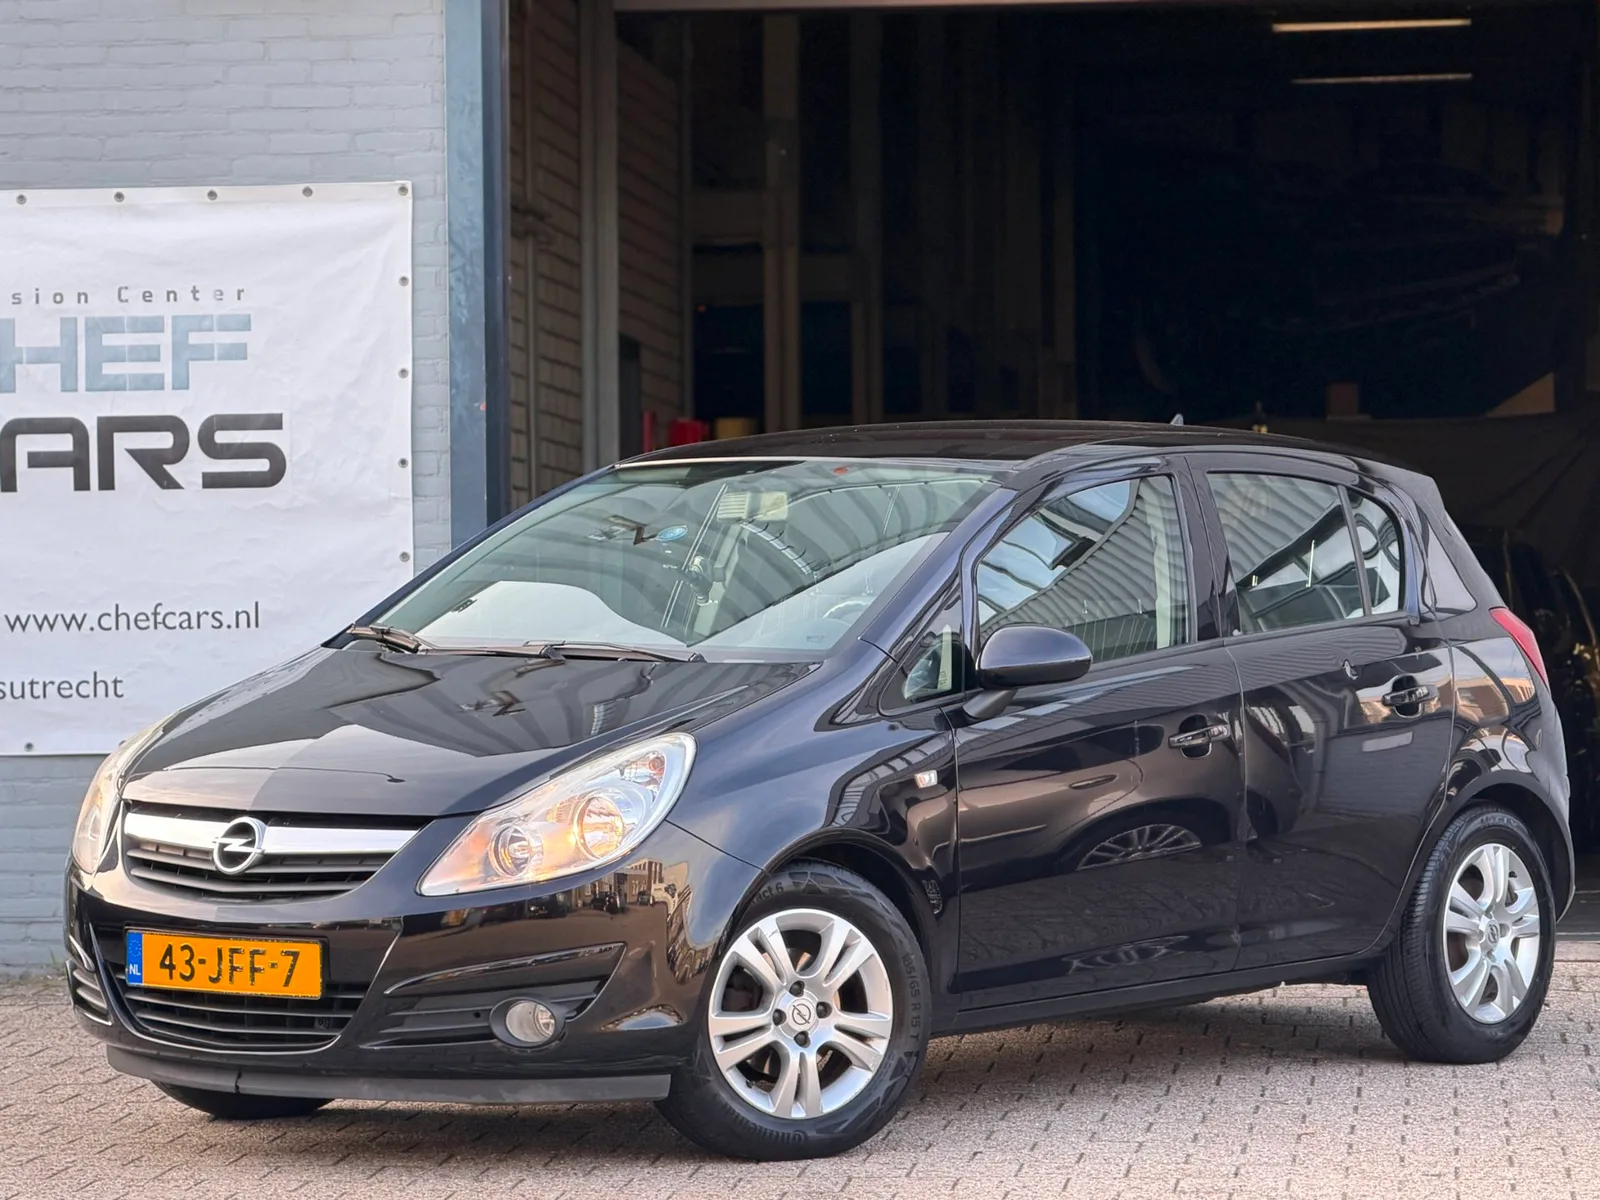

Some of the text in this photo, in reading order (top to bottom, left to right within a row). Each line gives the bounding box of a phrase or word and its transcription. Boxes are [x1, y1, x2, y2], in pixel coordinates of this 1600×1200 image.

[11, 285, 245, 305] sion Center
[0, 314, 251, 393] HEF
[0, 412, 287, 493] ARS
[4, 601, 260, 632] www.chefcars.nl
[128, 963, 141, 976] NL
[159, 943, 300, 987] 43-JFF-7
